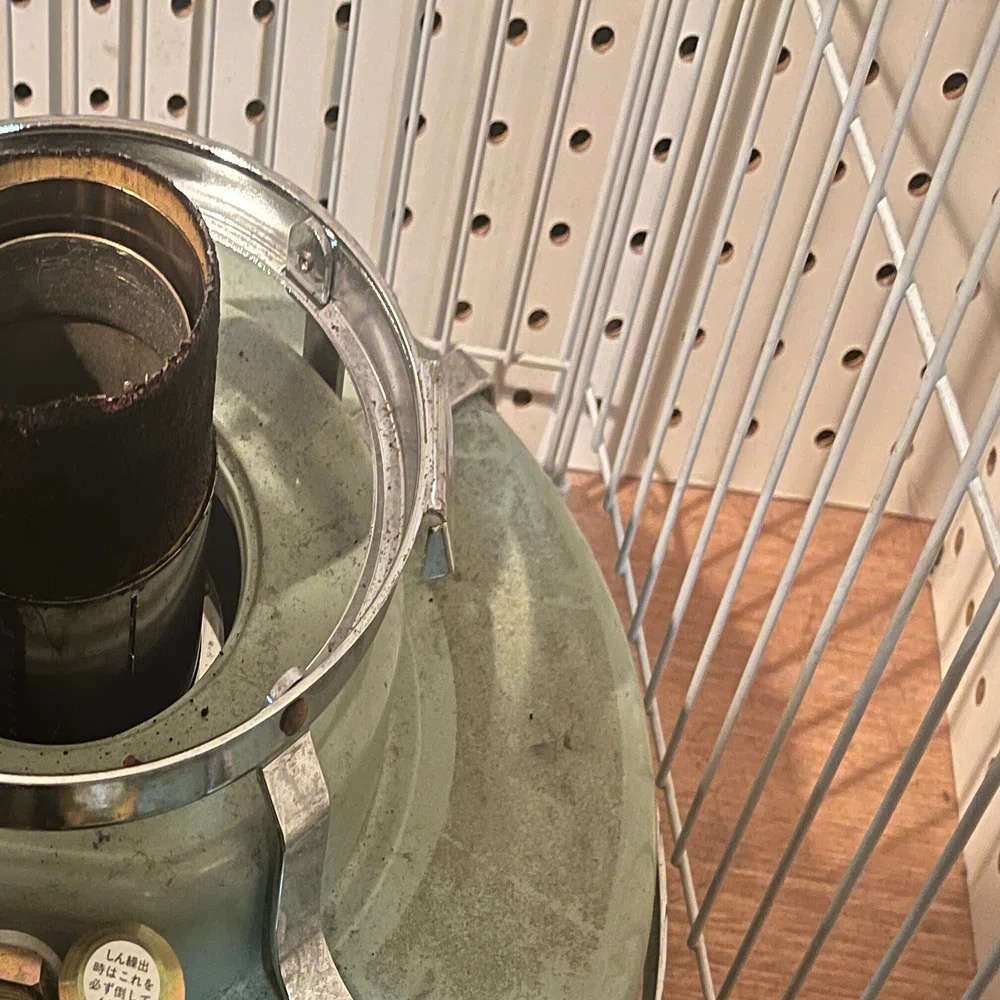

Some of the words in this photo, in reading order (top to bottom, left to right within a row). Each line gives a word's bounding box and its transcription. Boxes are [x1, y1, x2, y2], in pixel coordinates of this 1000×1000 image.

[106, 949, 149, 973] しん繰出
[92, 961, 154, 992] 時はこれを
